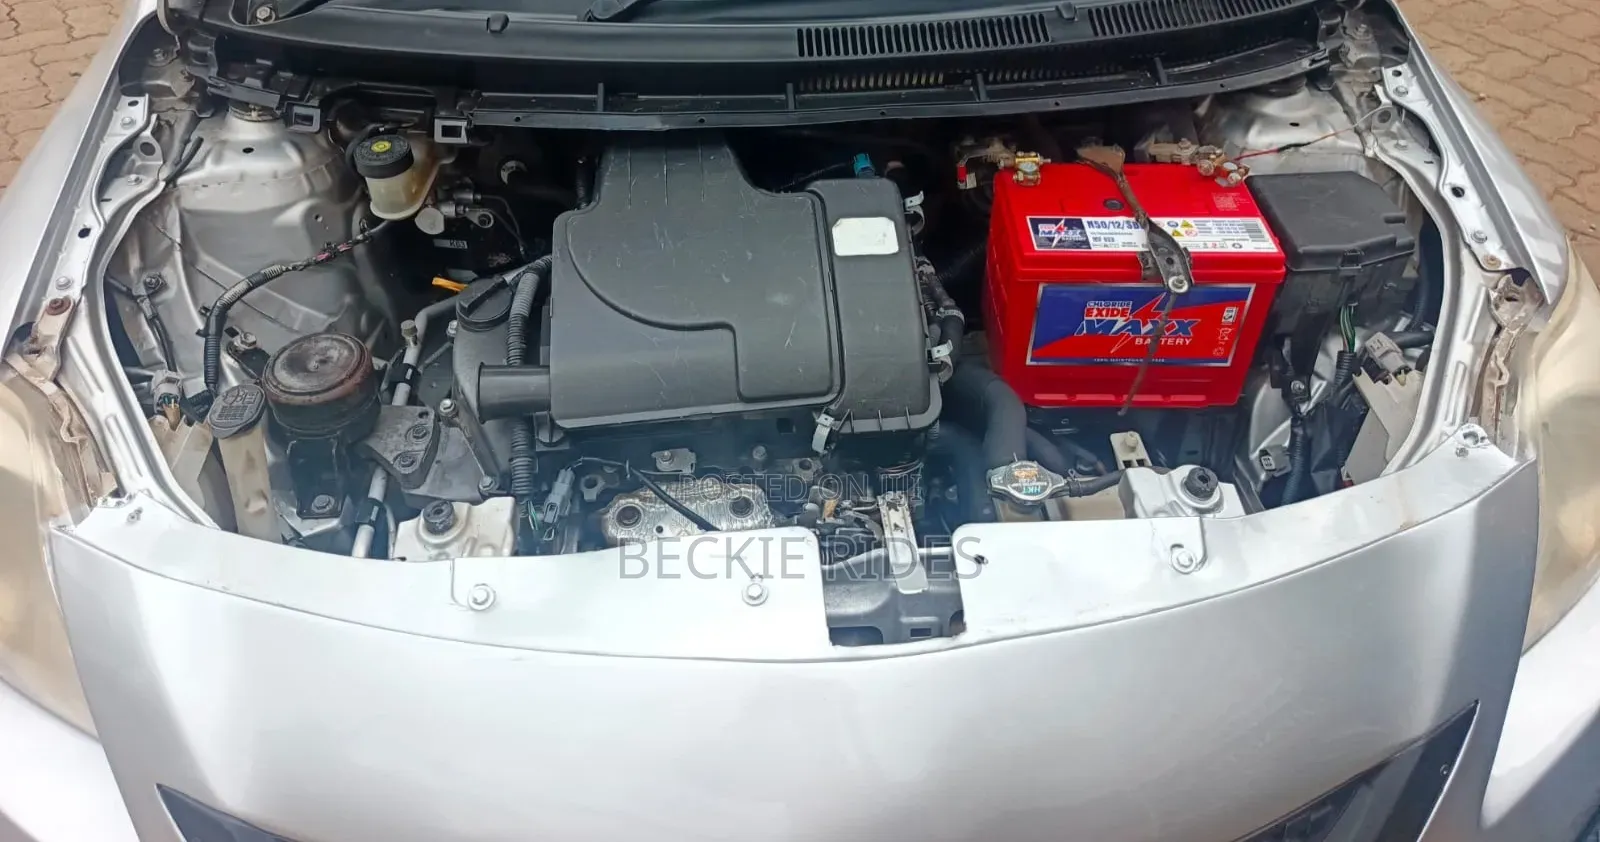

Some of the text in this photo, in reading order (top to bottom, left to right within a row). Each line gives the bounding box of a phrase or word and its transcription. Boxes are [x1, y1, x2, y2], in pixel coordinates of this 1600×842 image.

[1086, 300, 1133, 308] CHLORIDE
[1085, 307, 1130, 319] EXIDE
[1074, 318, 1202, 337] MAXX
[1135, 337, 1193, 346] BATERY
